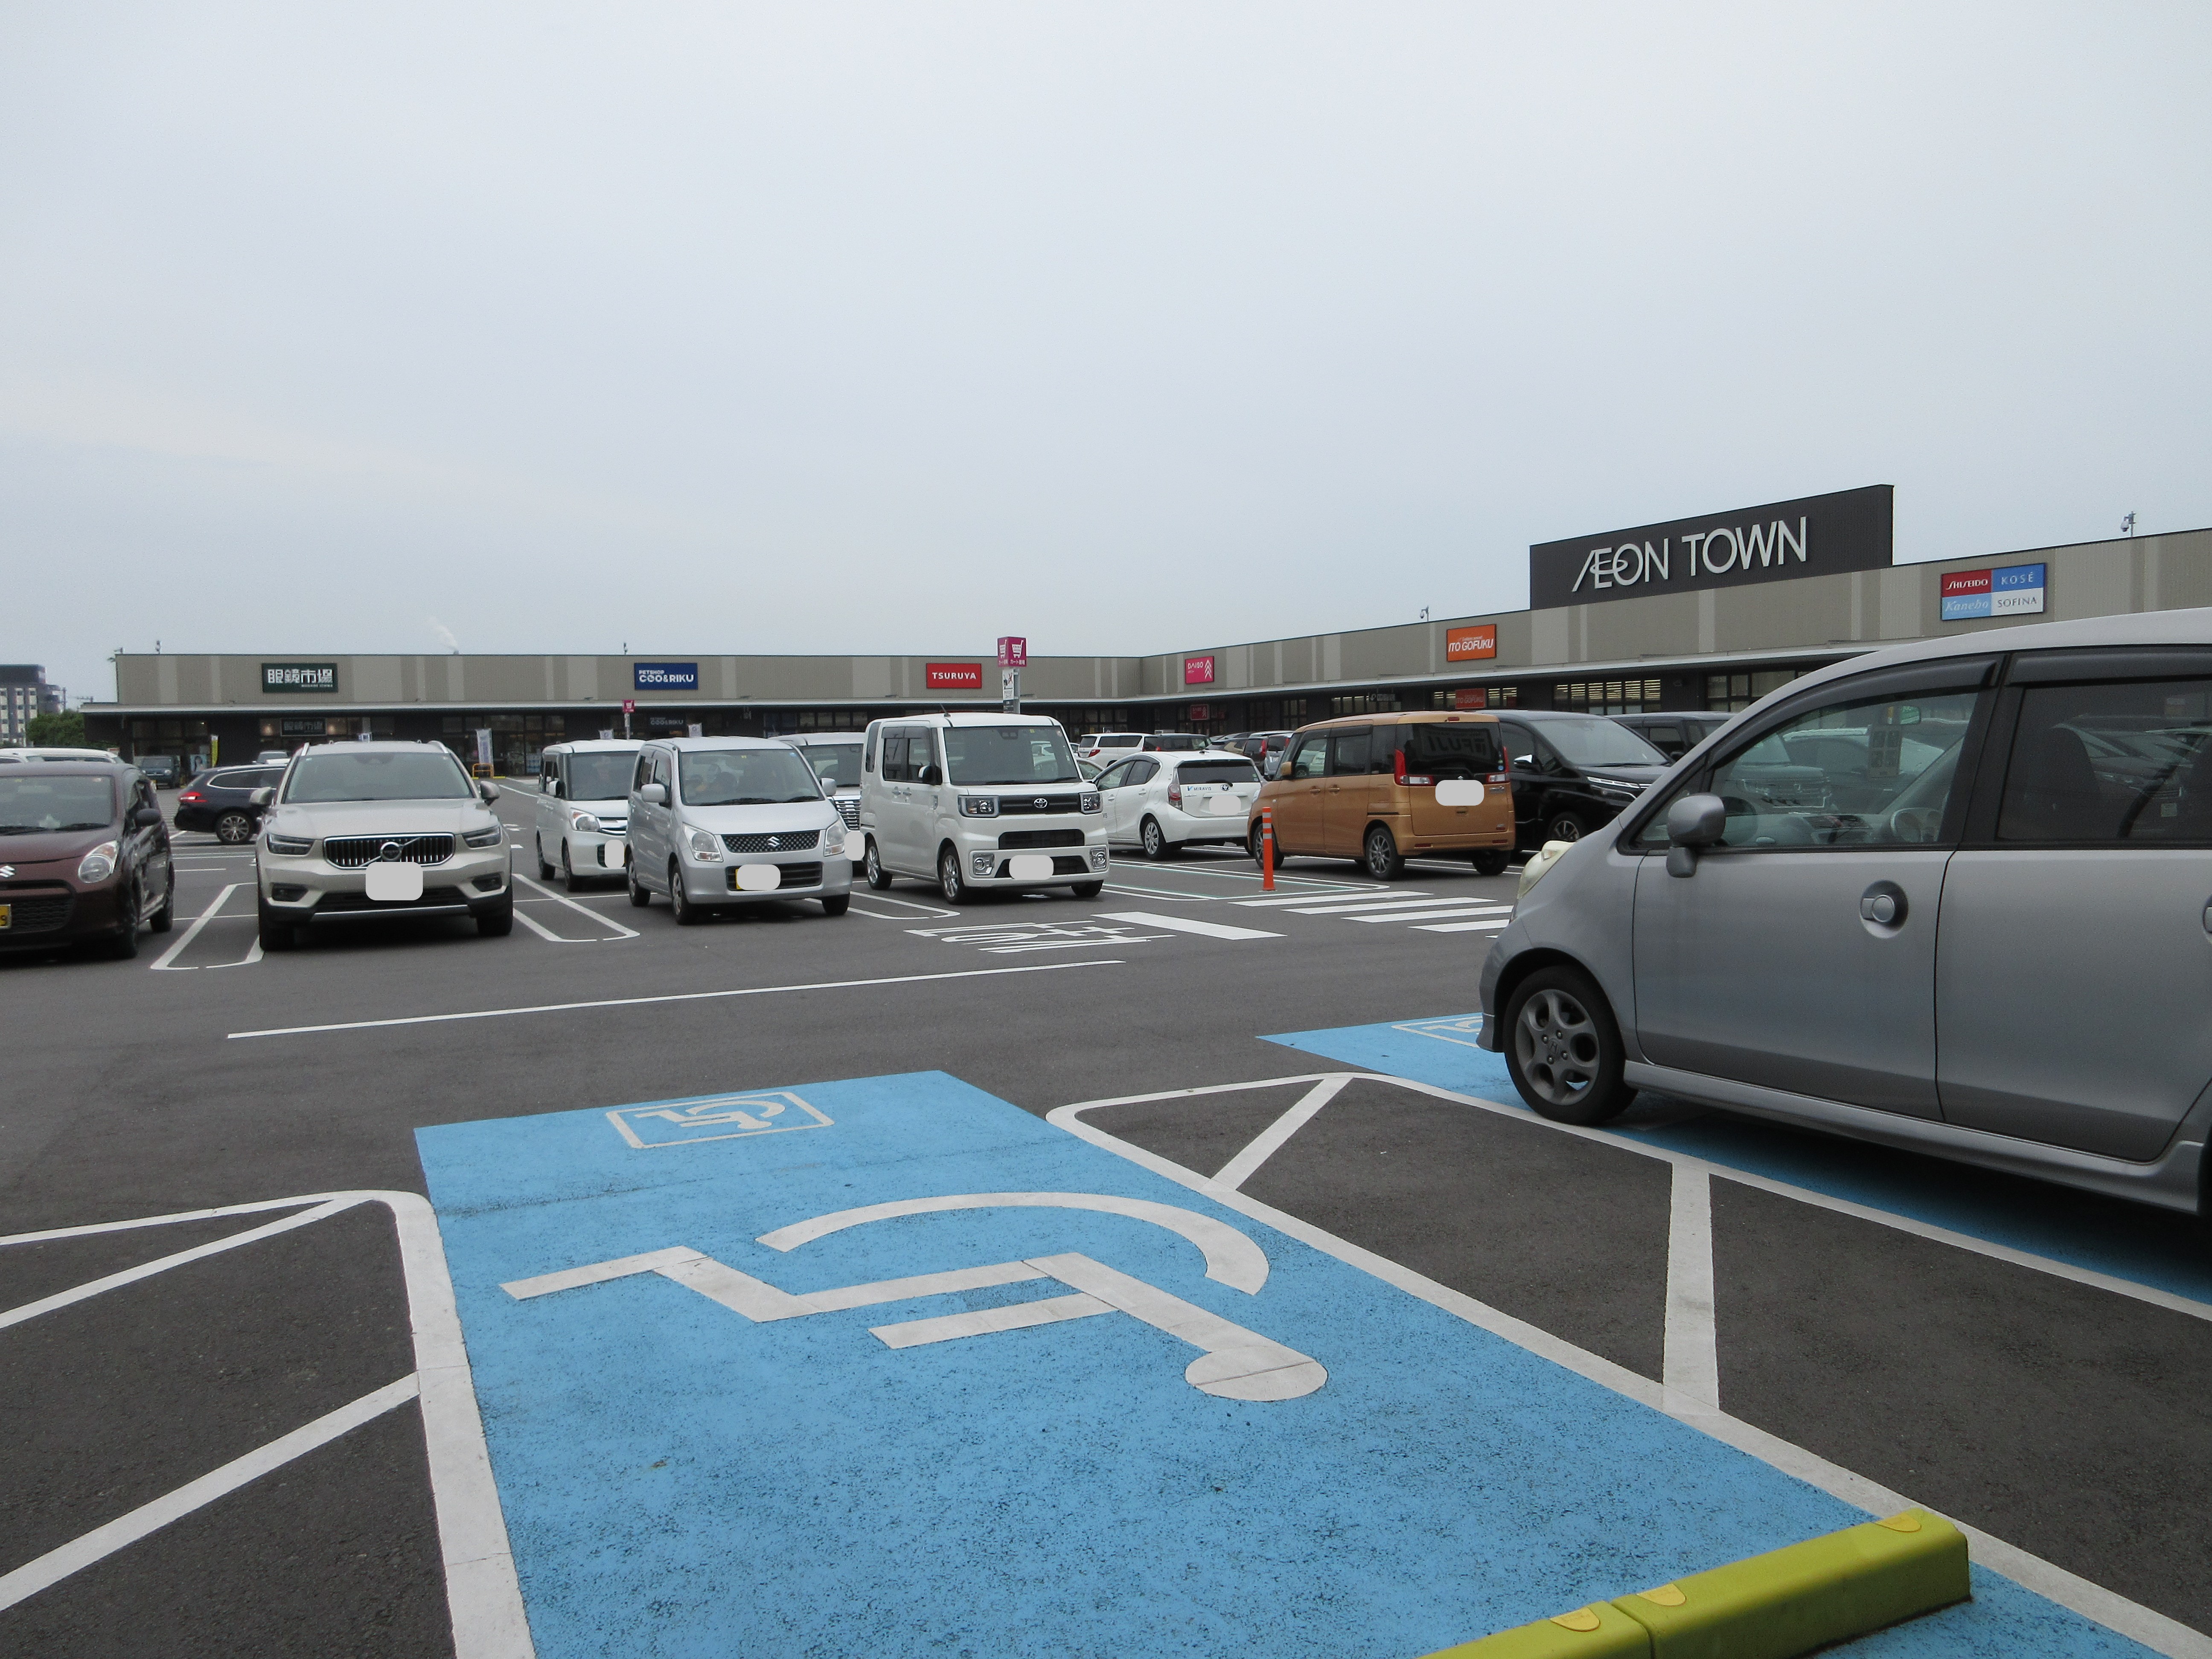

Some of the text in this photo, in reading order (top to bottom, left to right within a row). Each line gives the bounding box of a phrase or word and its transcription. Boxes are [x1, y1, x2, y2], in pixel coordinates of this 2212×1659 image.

[1681, 516, 1806, 576] TOWN
[1945, 579, 1988, 590] SHISEIDO
[2001, 571, 2034, 585] KOSÉ
[1945, 599, 1988, 612] Kanebo
[1997, 597, 2037, 608] SOFINA
[1448, 638, 1493, 652] ITO GOFUKU
[268, 669, 334, 684] 眼鏡市場
[639, 675, 694, 683] COO&RIKU
